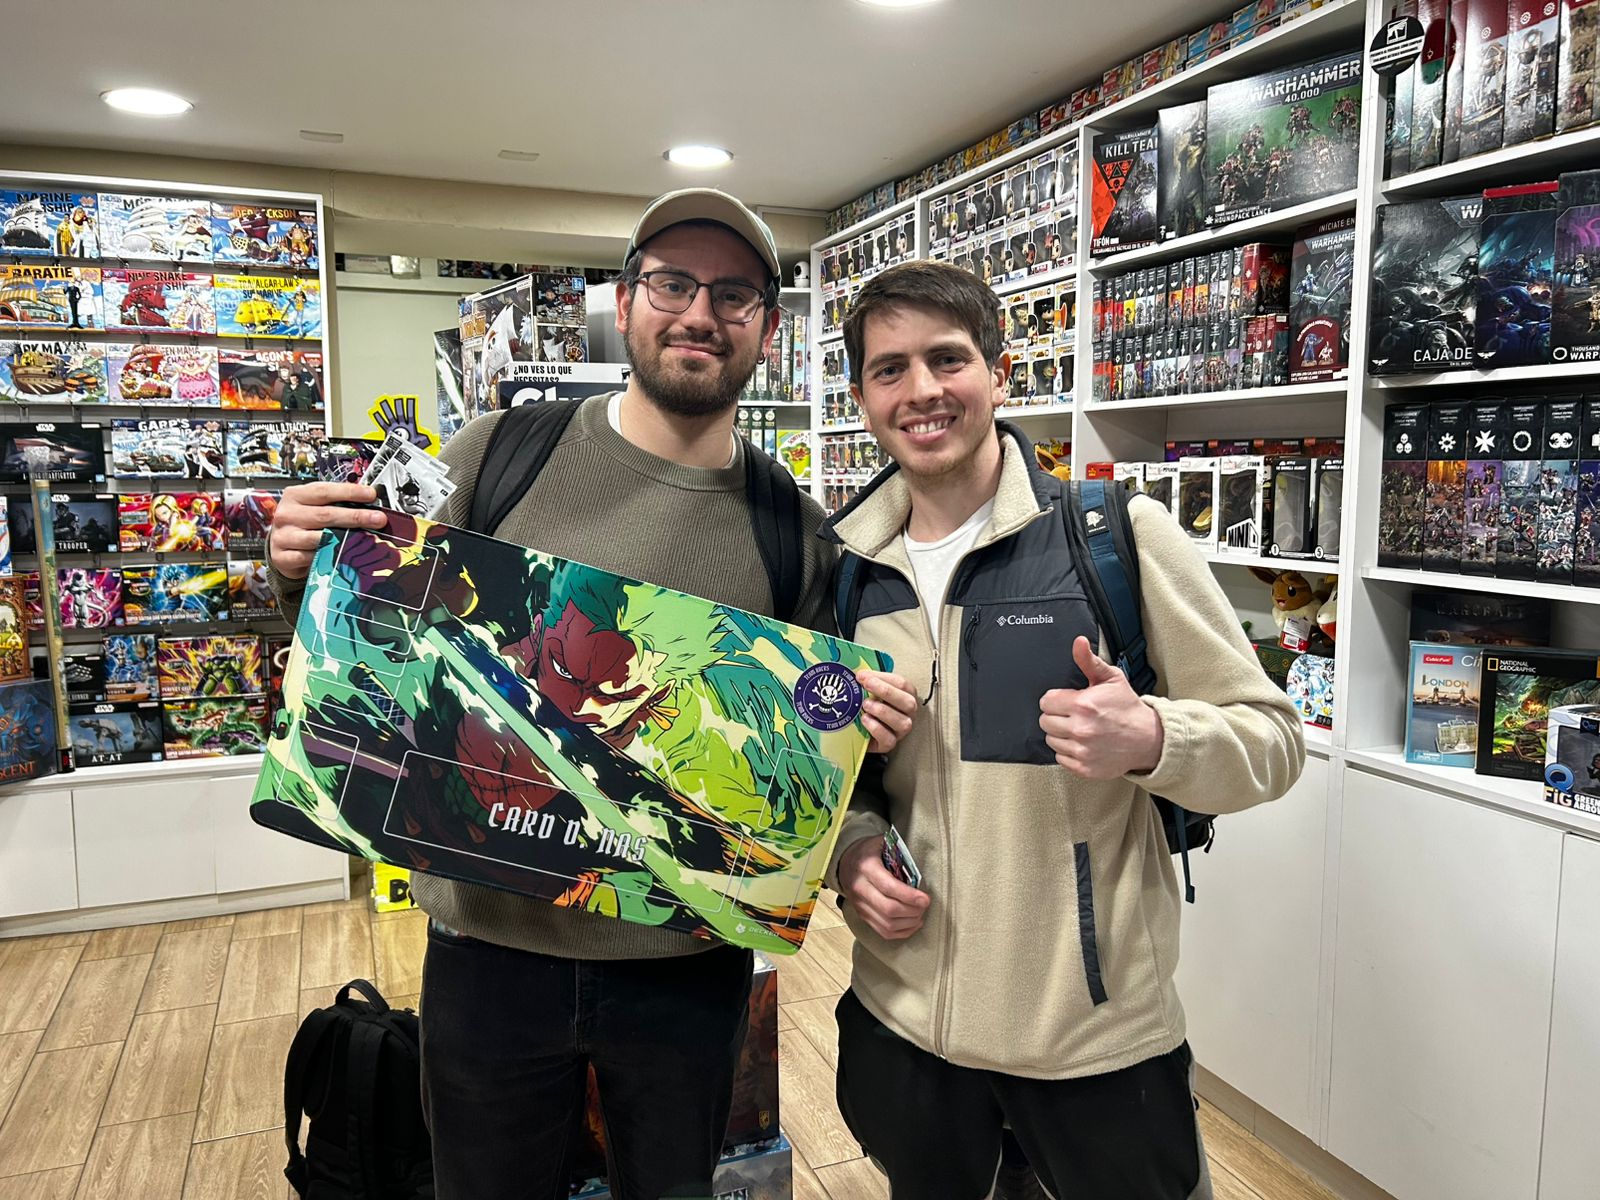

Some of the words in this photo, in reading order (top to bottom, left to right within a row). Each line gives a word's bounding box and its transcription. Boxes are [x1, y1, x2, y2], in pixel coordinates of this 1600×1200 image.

[1248, 59, 1361, 102] WARHAMMER
[1284, 87, 1320, 103] 40.000
[1105, 145, 1130, 158] KILL
[16, 192, 72, 202] MARINE
[1311, 231, 1356, 250] WARHAMME
[12, 266, 73, 279] BARATIE
[153, 271, 188, 282] SNAKE
[165, 280, 188, 291] SHIP
[1413, 349, 1450, 362] CAJA
[1454, 346, 1473, 360] DE
[1570, 352, 1600, 360] WARP
[513, 365, 528, 376] ¿NO
[530, 365, 545, 375] VES
[547, 366, 556, 375] LO
[558, 366, 572, 375] QUE
[138, 418, 190, 431] GARP'S
[58, 541, 88, 550] TROOPER
[1007, 614, 1054, 626] Columbia
[1499, 665, 1537, 674] GEOGRAPHIC
[488, 802, 556, 840] CARD
[596, 828, 649, 862] NAS
